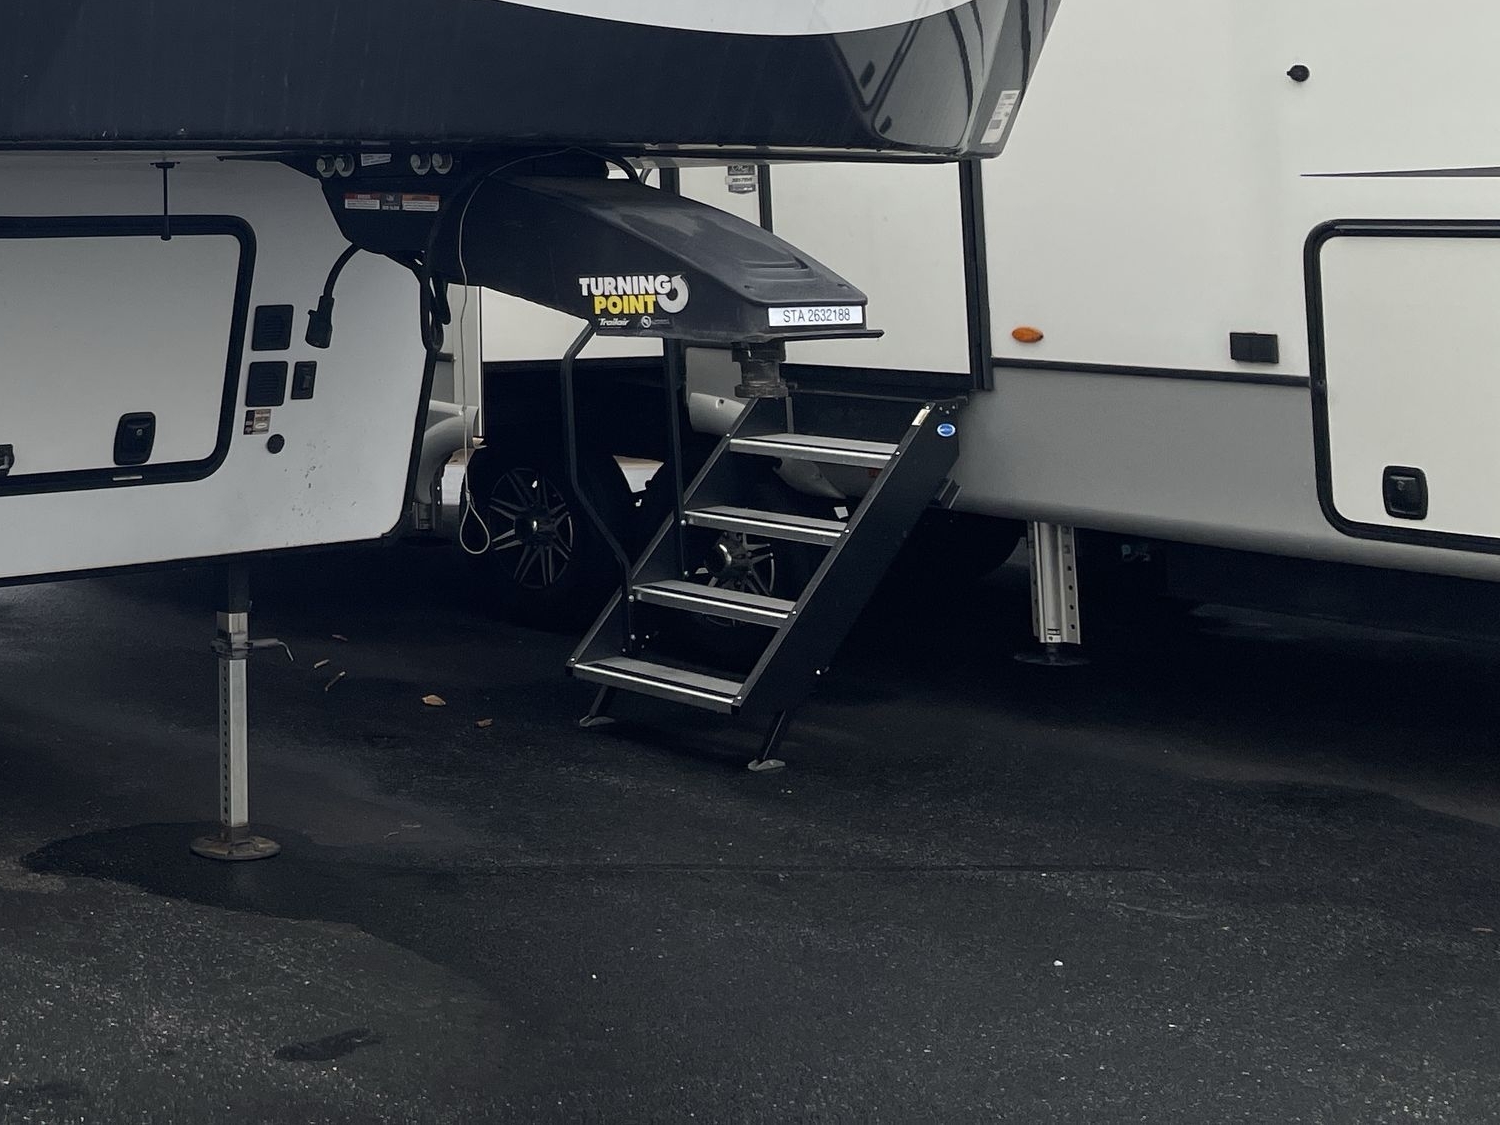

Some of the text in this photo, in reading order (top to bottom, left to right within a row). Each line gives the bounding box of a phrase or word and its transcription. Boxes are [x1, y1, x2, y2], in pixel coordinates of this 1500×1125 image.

[578, 274, 672, 296] TURNING
[594, 295, 656, 315] POINT
[782, 307, 851, 323] STA 2632188
